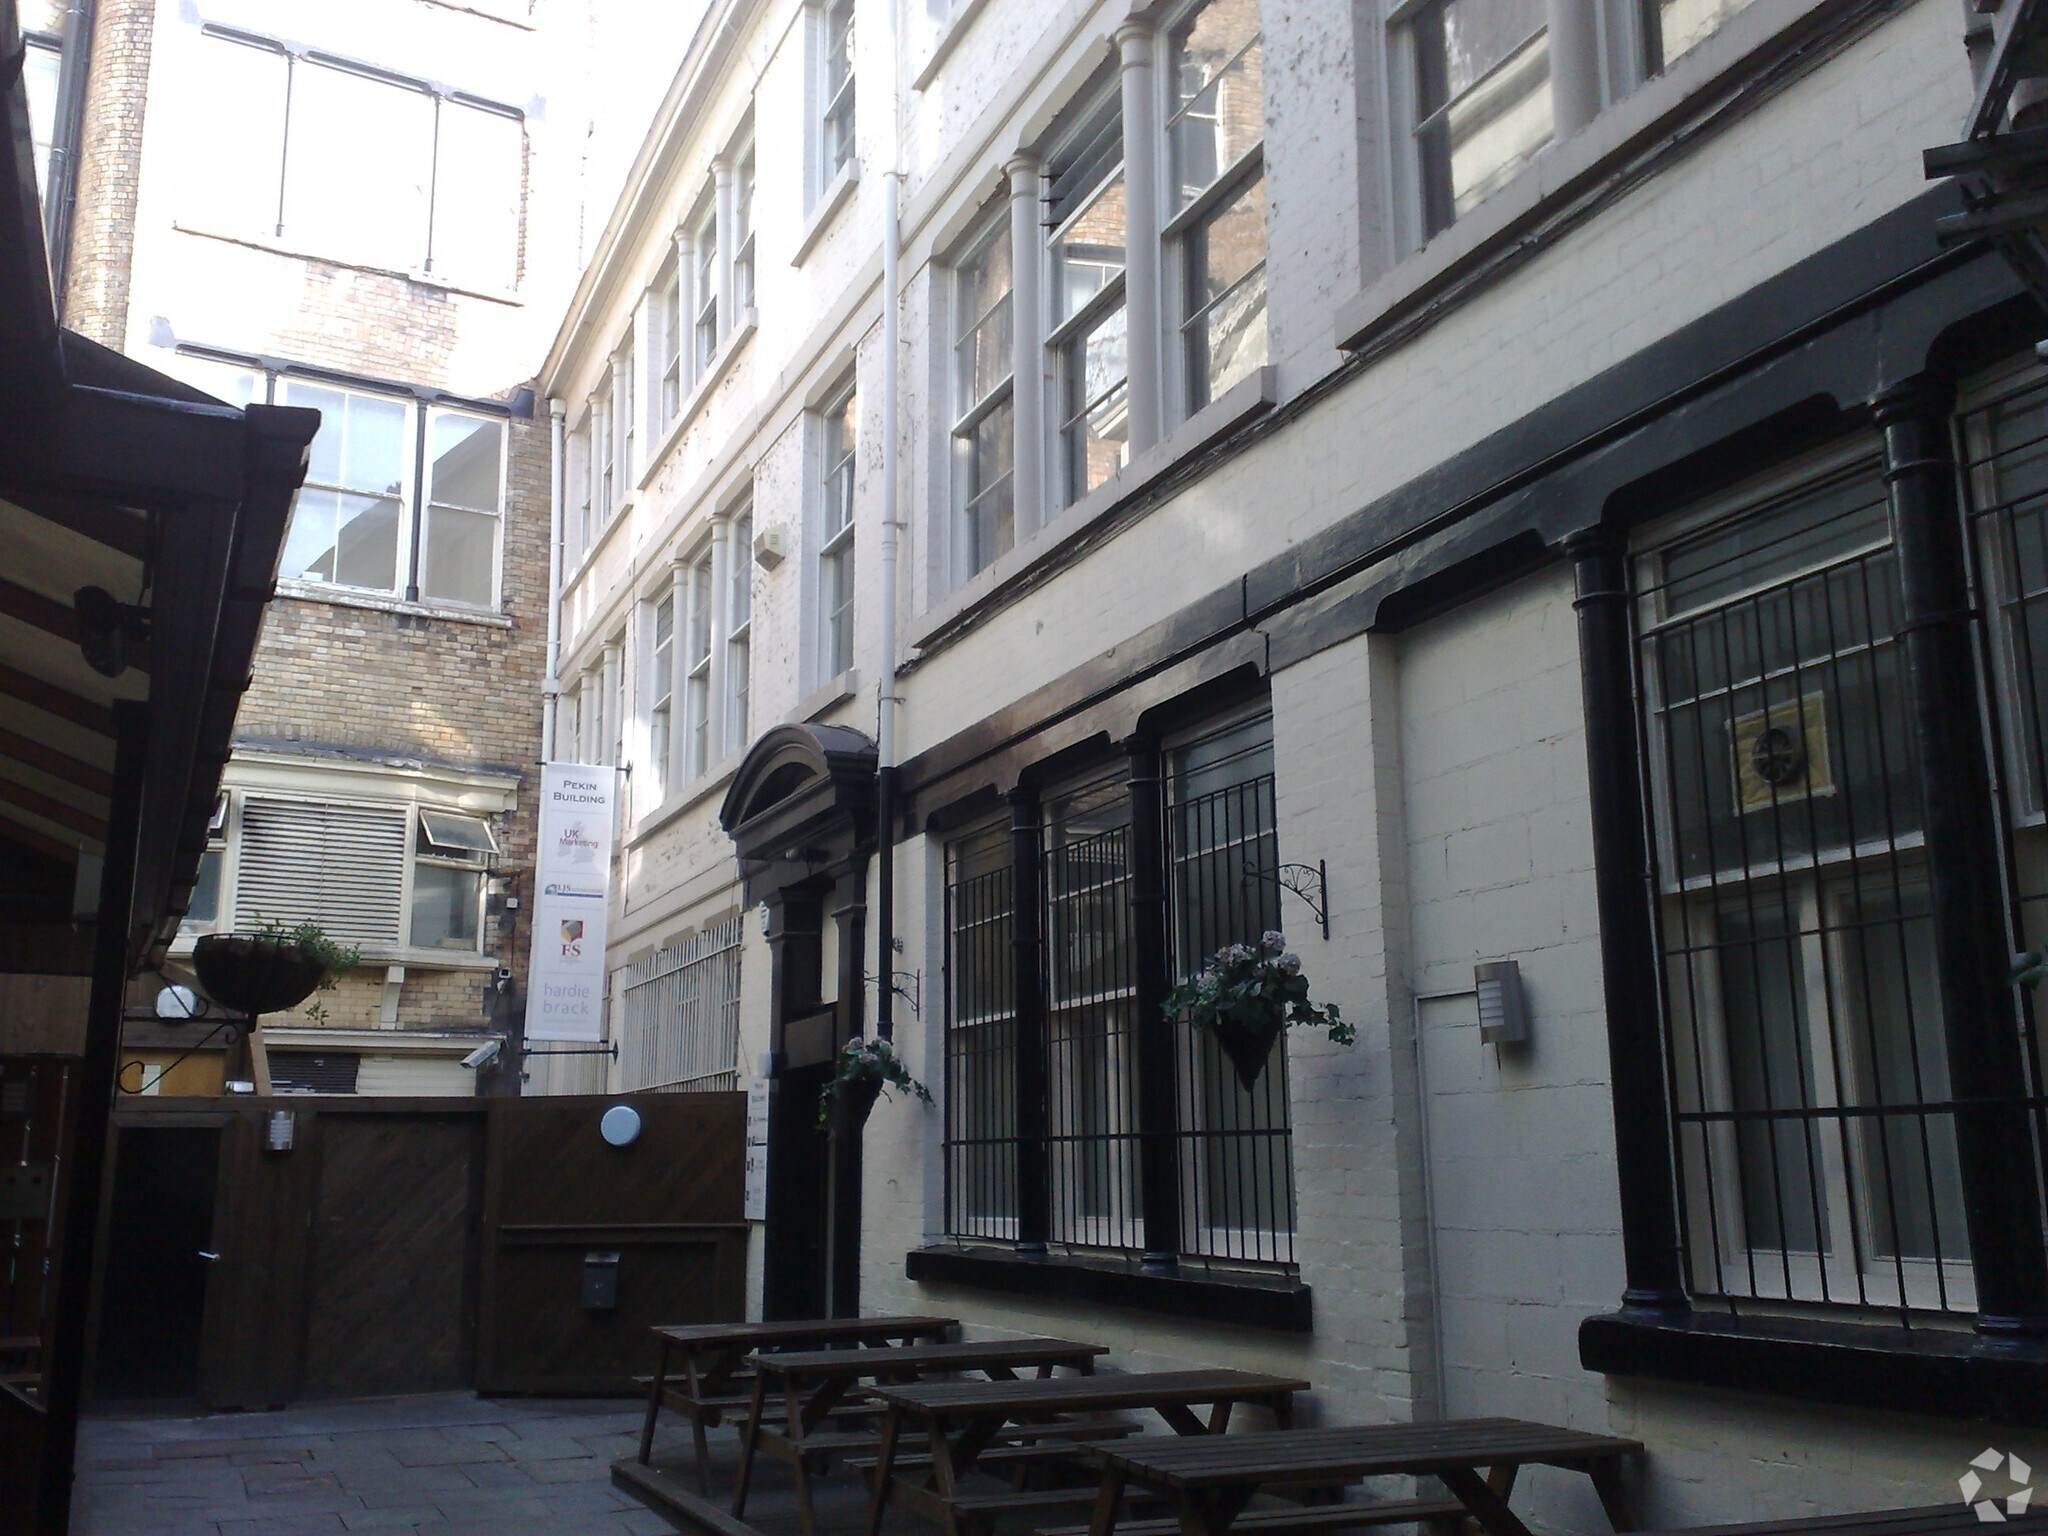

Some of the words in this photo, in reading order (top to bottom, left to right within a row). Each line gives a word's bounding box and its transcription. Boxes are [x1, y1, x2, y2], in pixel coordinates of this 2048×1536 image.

[563, 780, 597, 791] PEKIN
[553, 792, 606, 804] BUILDING
[564, 829, 579, 839] UK
[561, 944, 581, 957] FS
[544, 982, 590, 998] hardie
[543, 1000, 589, 1015] brack
